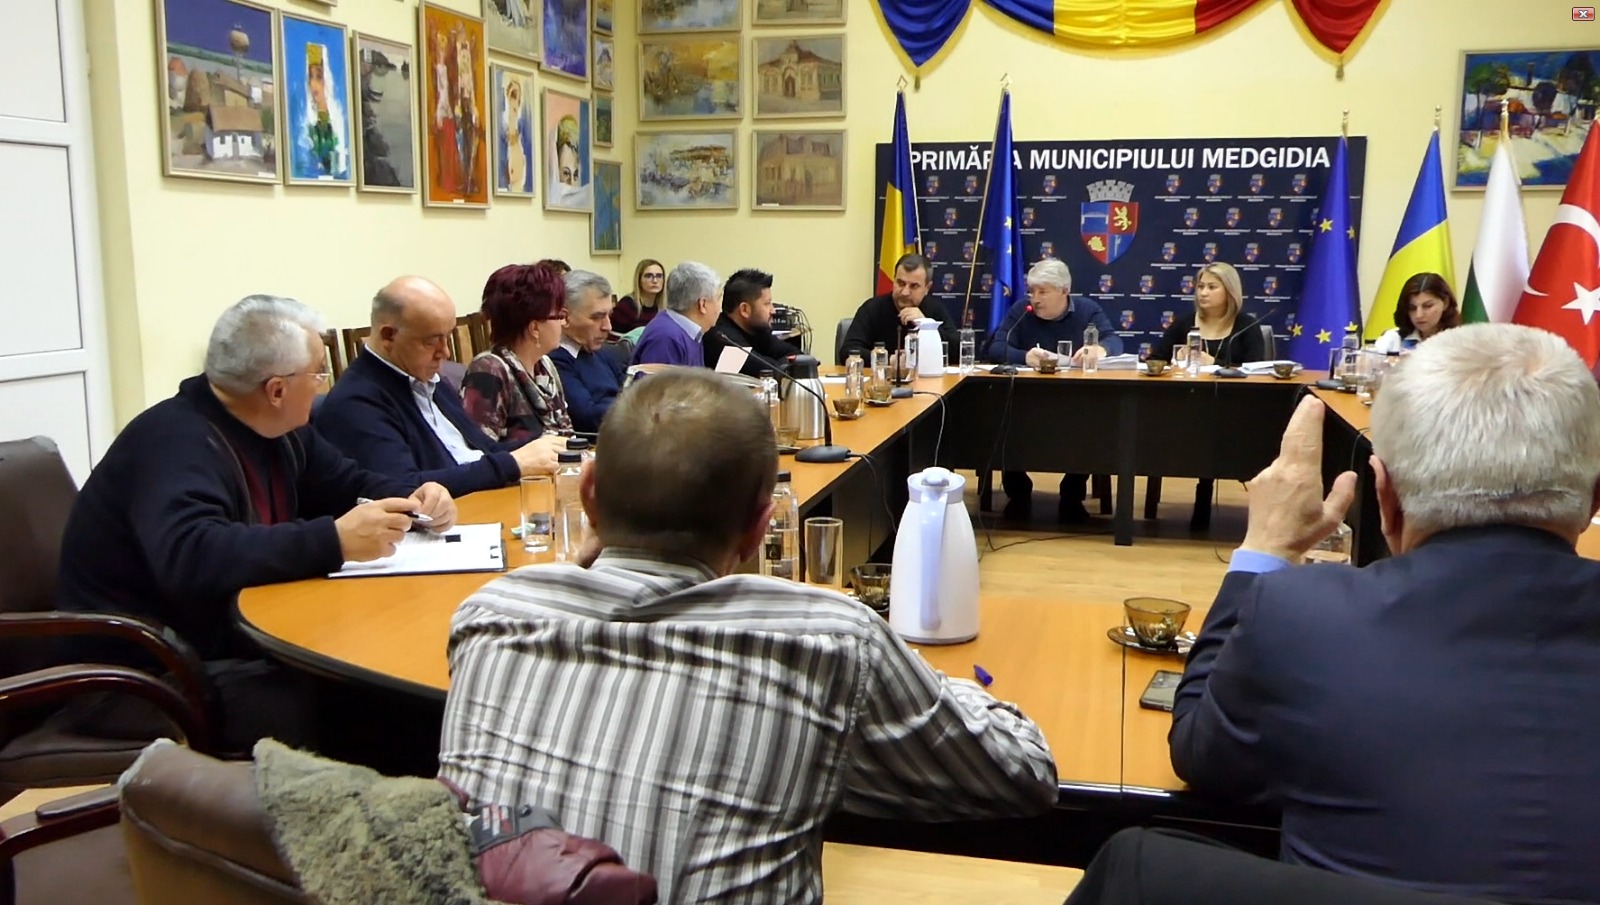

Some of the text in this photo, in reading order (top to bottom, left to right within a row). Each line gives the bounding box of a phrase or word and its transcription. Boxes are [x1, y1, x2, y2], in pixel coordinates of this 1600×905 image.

[911, 145, 1331, 170] PRIMĂA MUNICIPIULUI MEDGIDIA
